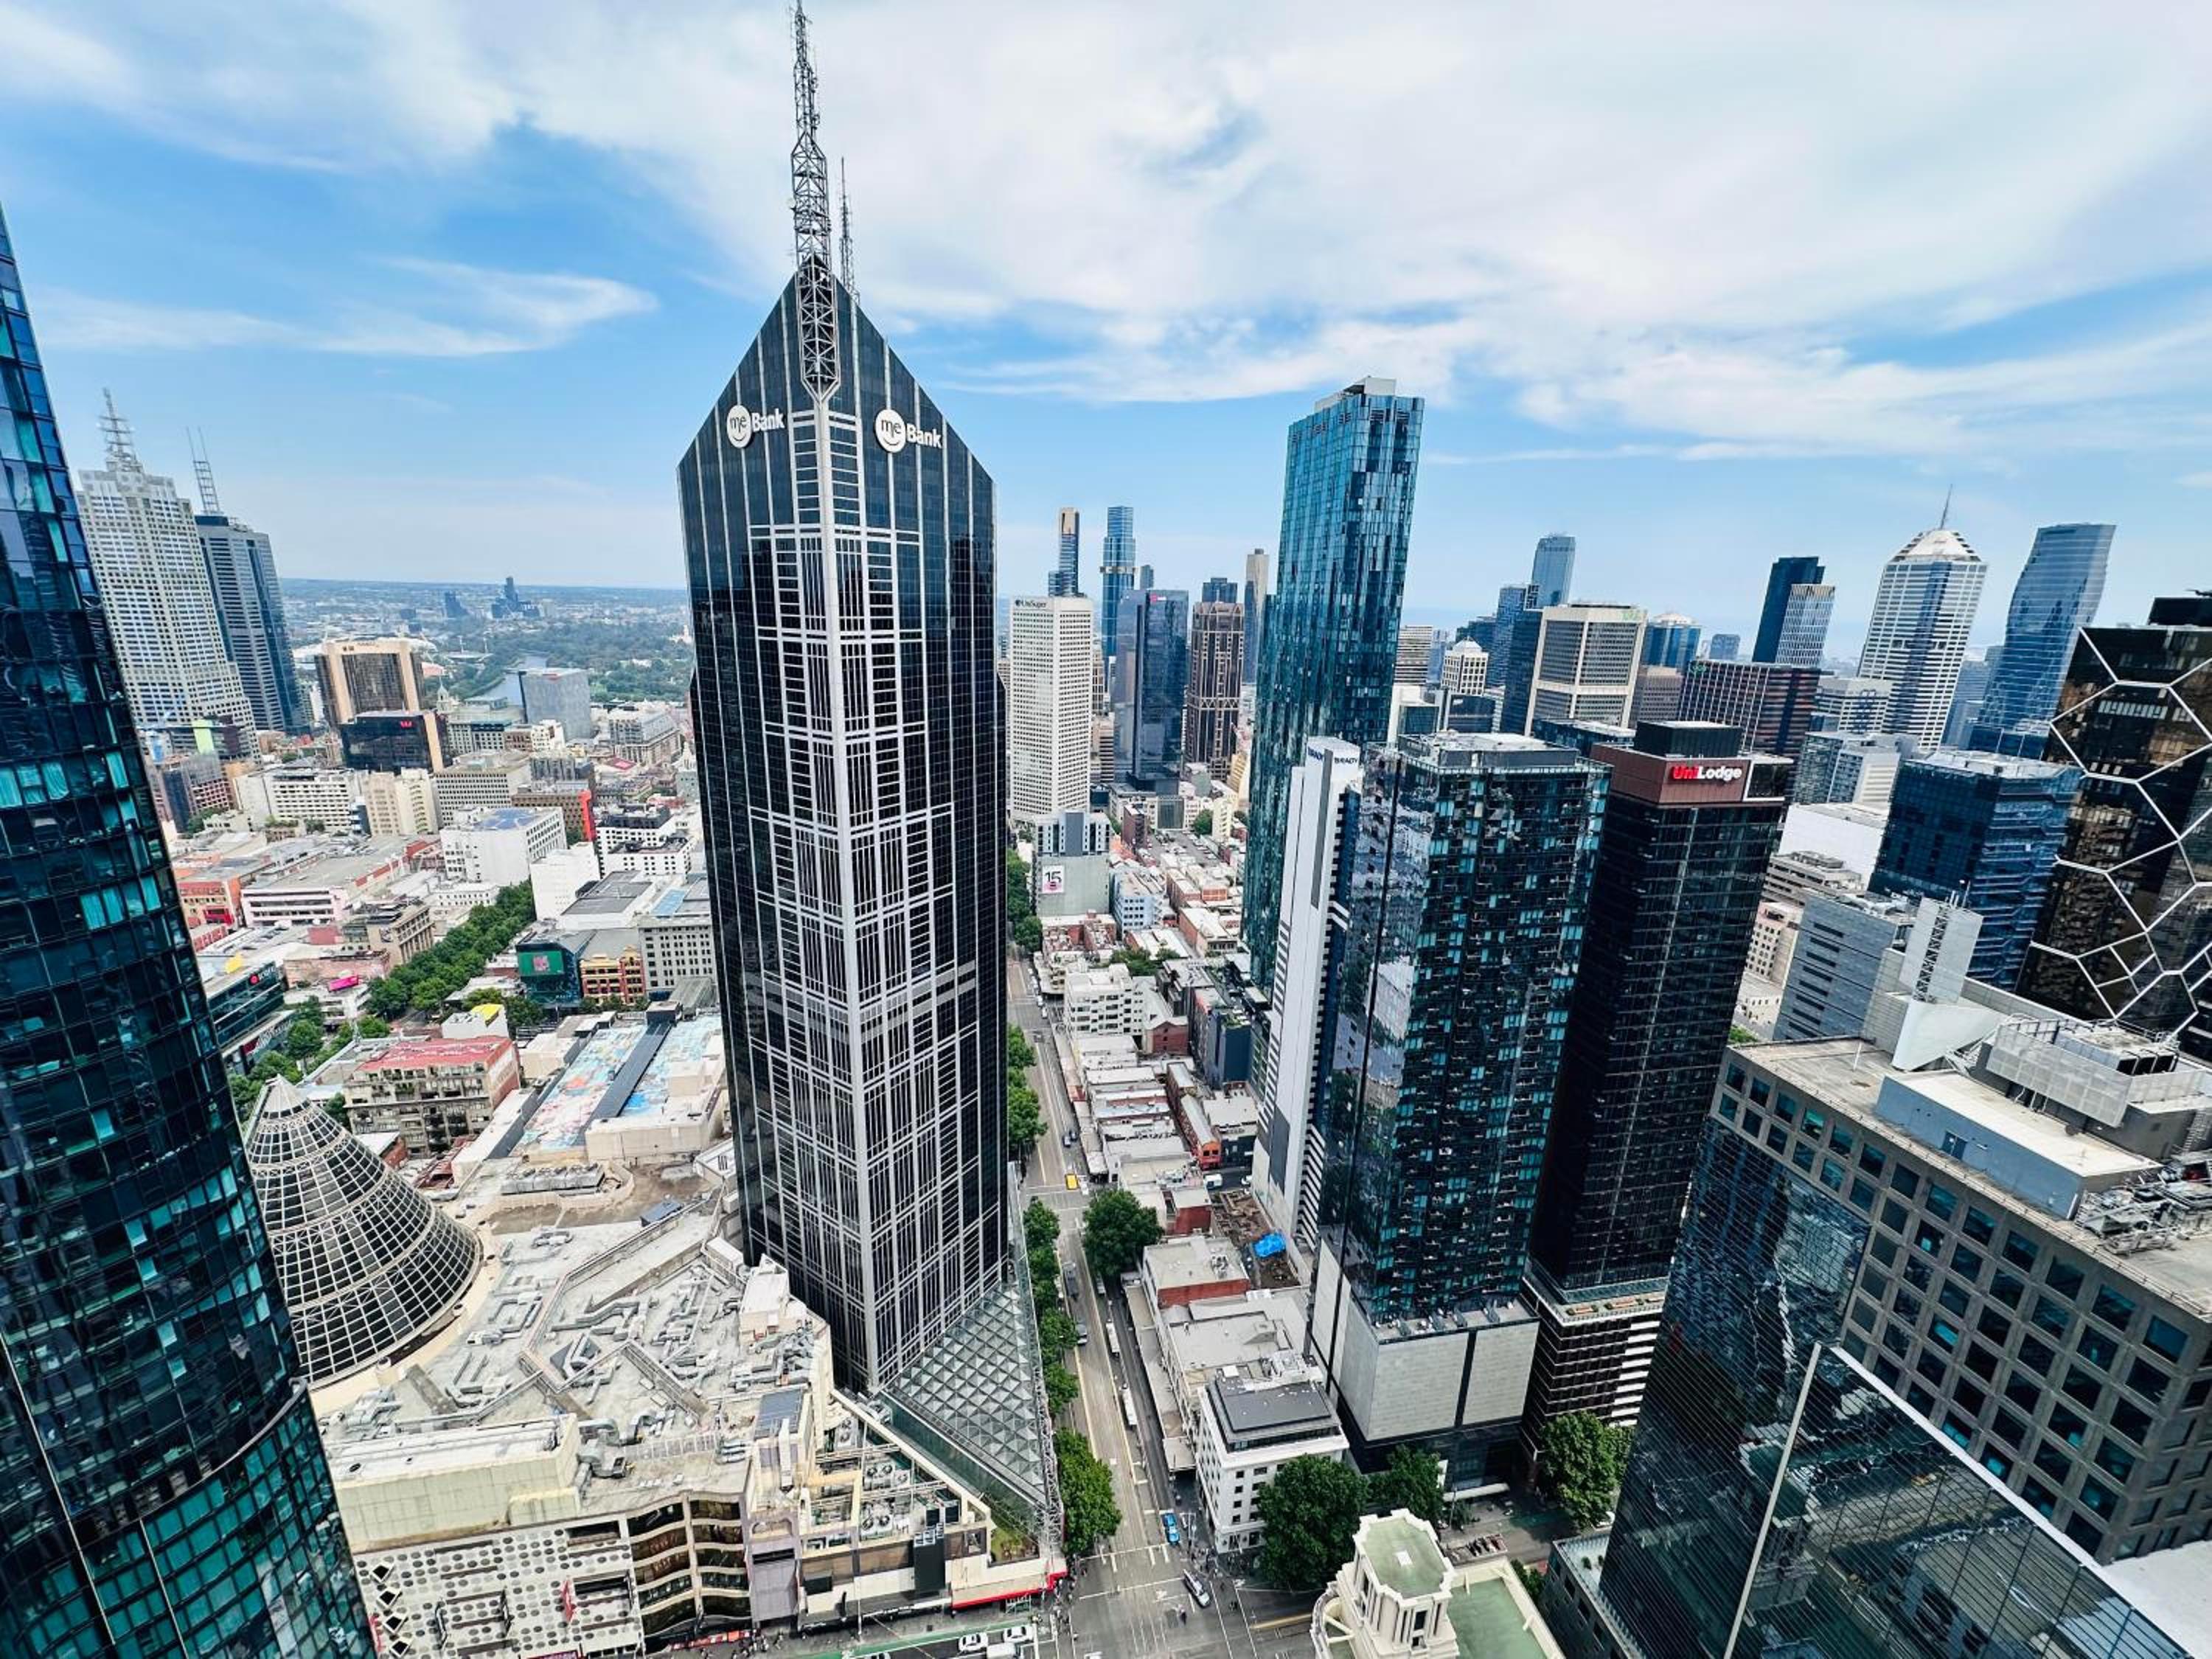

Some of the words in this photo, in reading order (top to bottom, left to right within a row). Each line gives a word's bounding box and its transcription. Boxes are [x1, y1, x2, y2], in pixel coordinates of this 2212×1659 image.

[751, 408, 785, 433] Bank
[906, 422, 942, 449] Bank
[1673, 765, 1742, 782] UniLodge
[1045, 871, 1061, 883] 15
